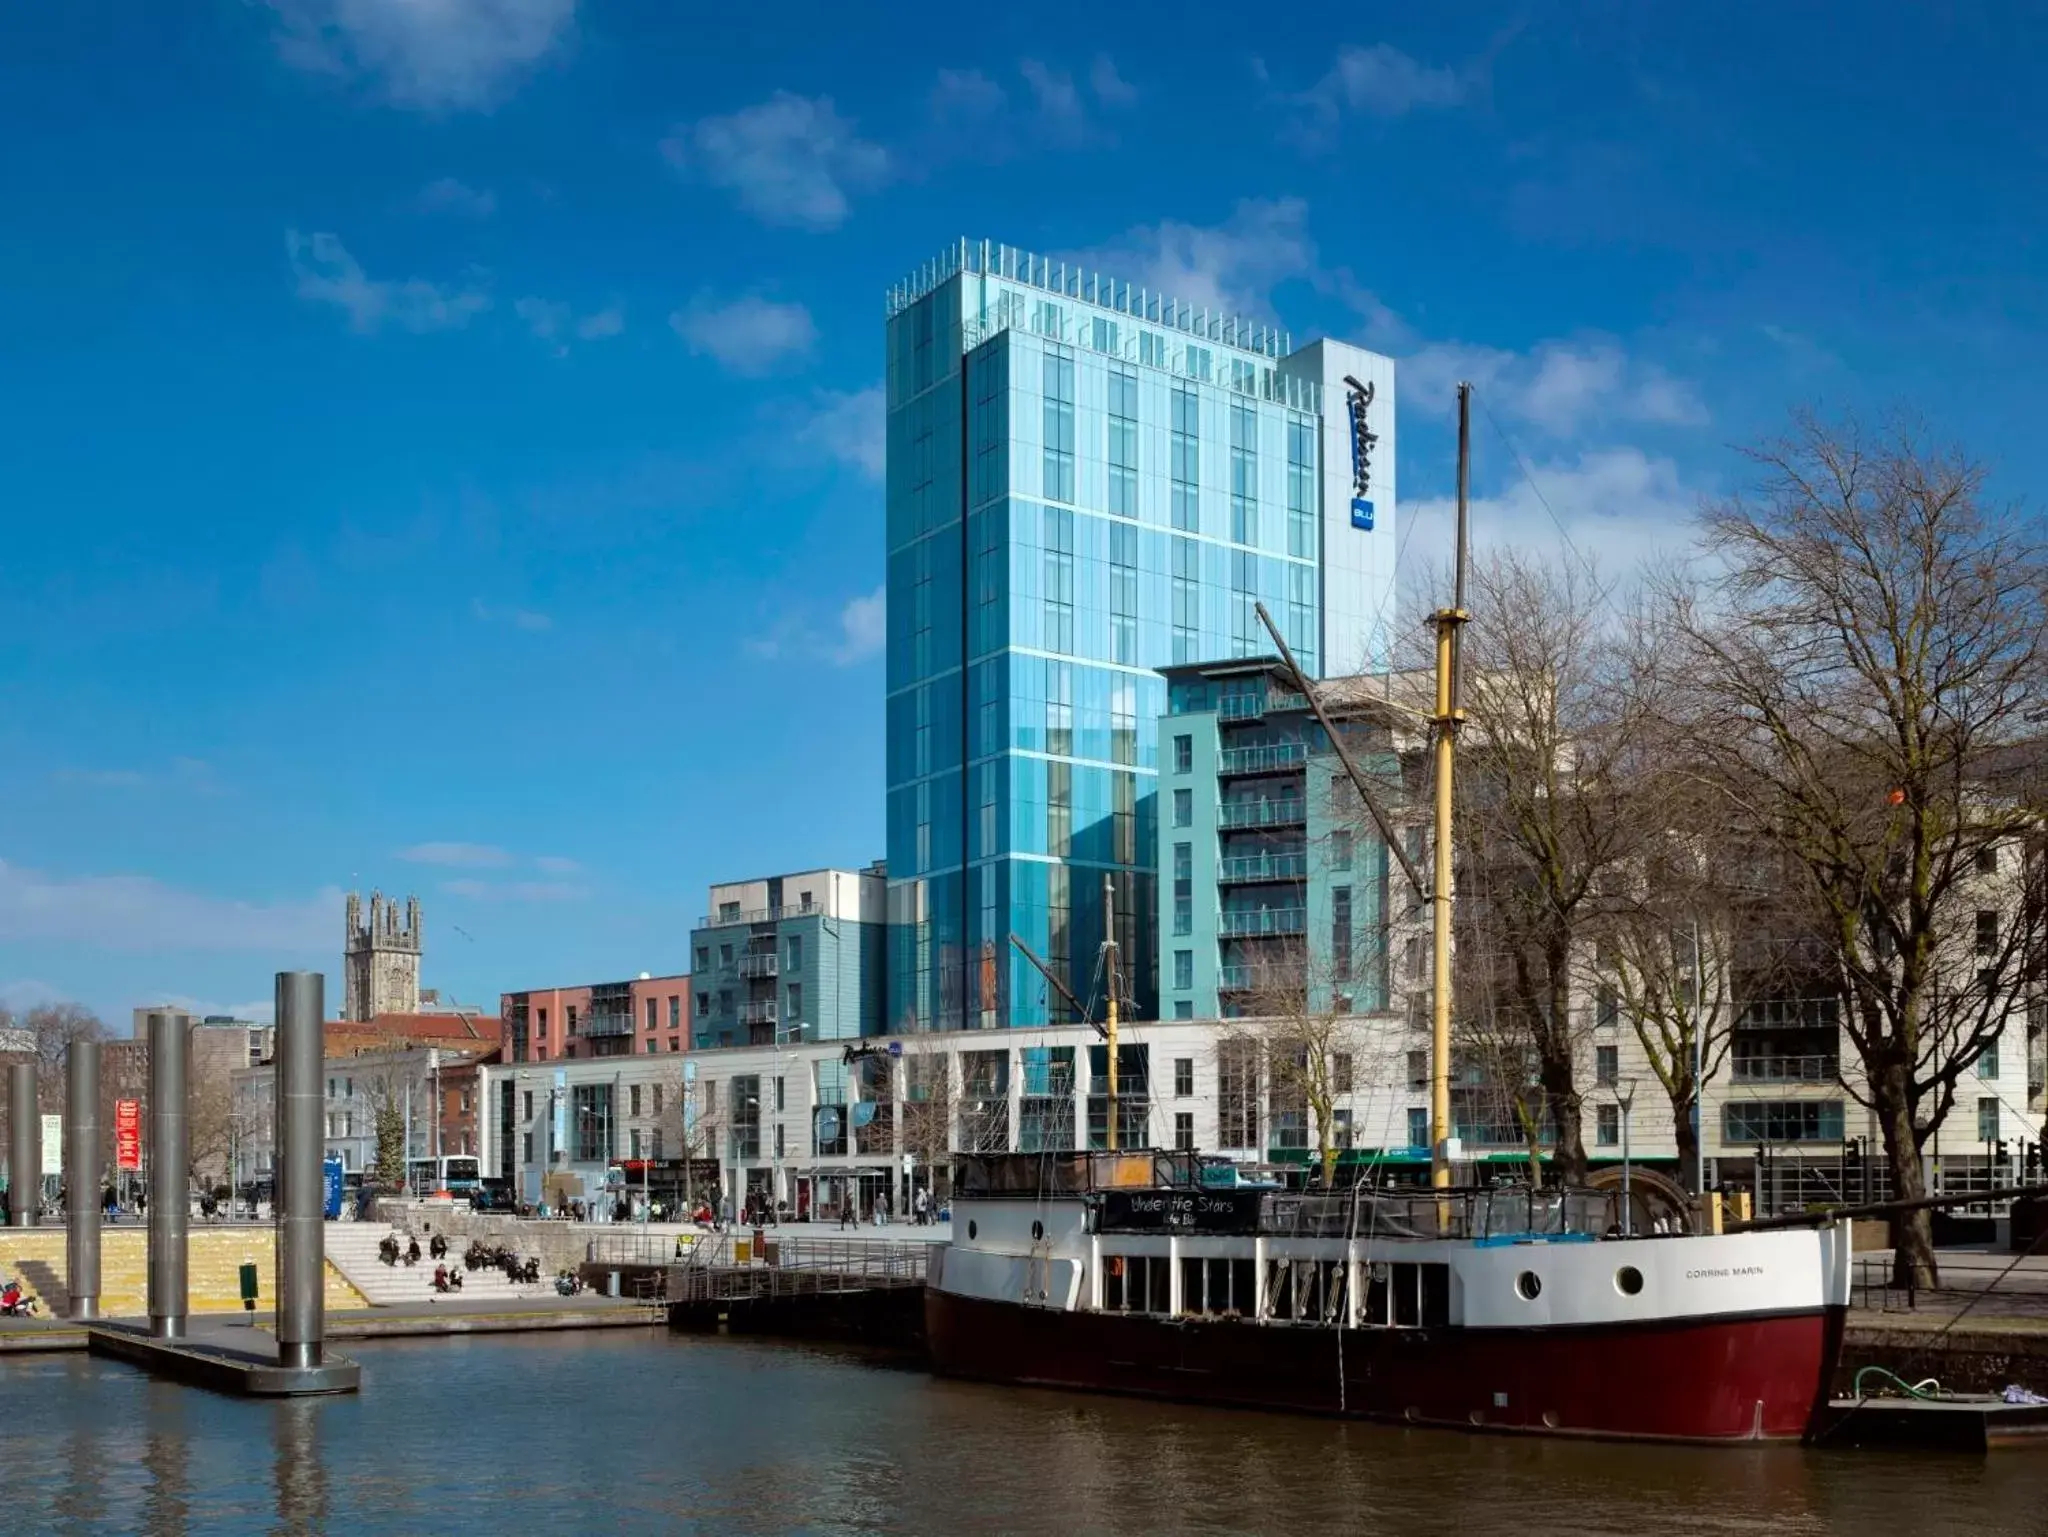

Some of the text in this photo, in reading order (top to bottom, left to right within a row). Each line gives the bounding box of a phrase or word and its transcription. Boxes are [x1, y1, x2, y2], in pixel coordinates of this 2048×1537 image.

[1343, 375, 1379, 498] Radisson
[1172, 1195, 1193, 1212] the
[1199, 1196, 1234, 1213] Stars
[1732, 1265, 1764, 1276] MARIN
